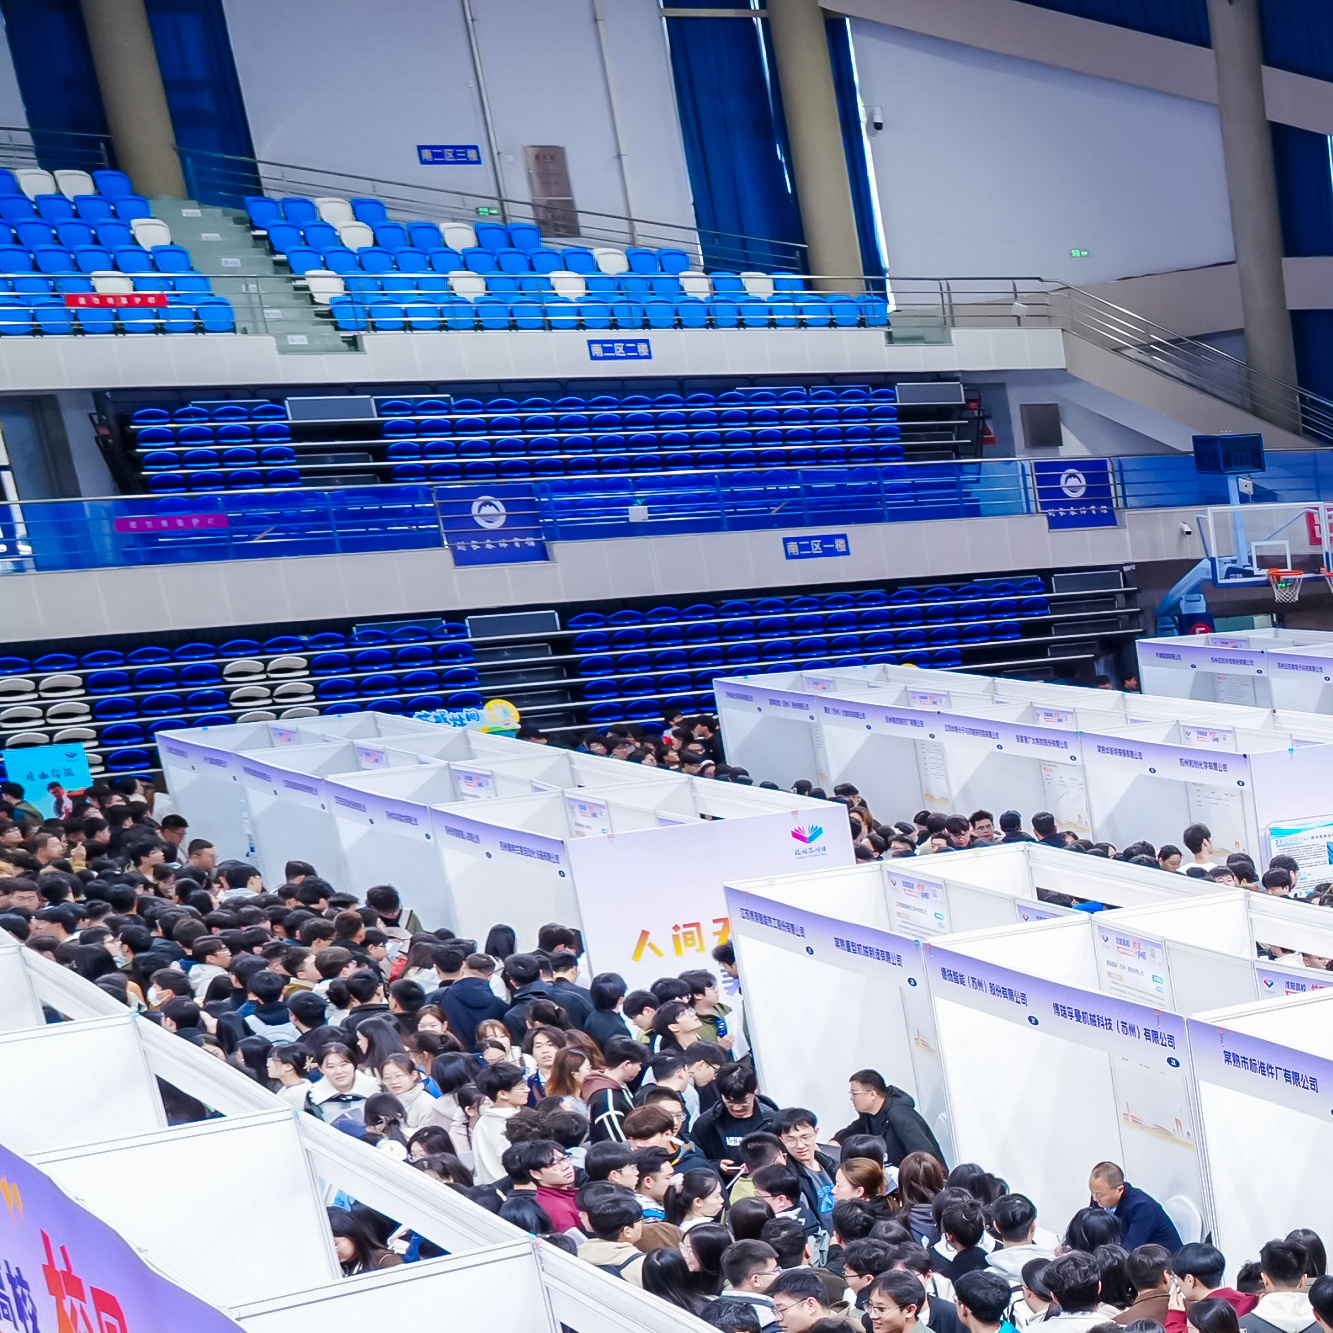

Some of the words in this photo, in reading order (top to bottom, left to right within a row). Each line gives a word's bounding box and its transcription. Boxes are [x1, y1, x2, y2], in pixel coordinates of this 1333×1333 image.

[421, 149, 478, 161] 南二区三楼
[591, 343, 650, 357] 南二区二楼
[786, 538, 847, 555] 南二区一楼
[1222, 1049, 1319, 1094] 常熟市标准件厂有限公司
